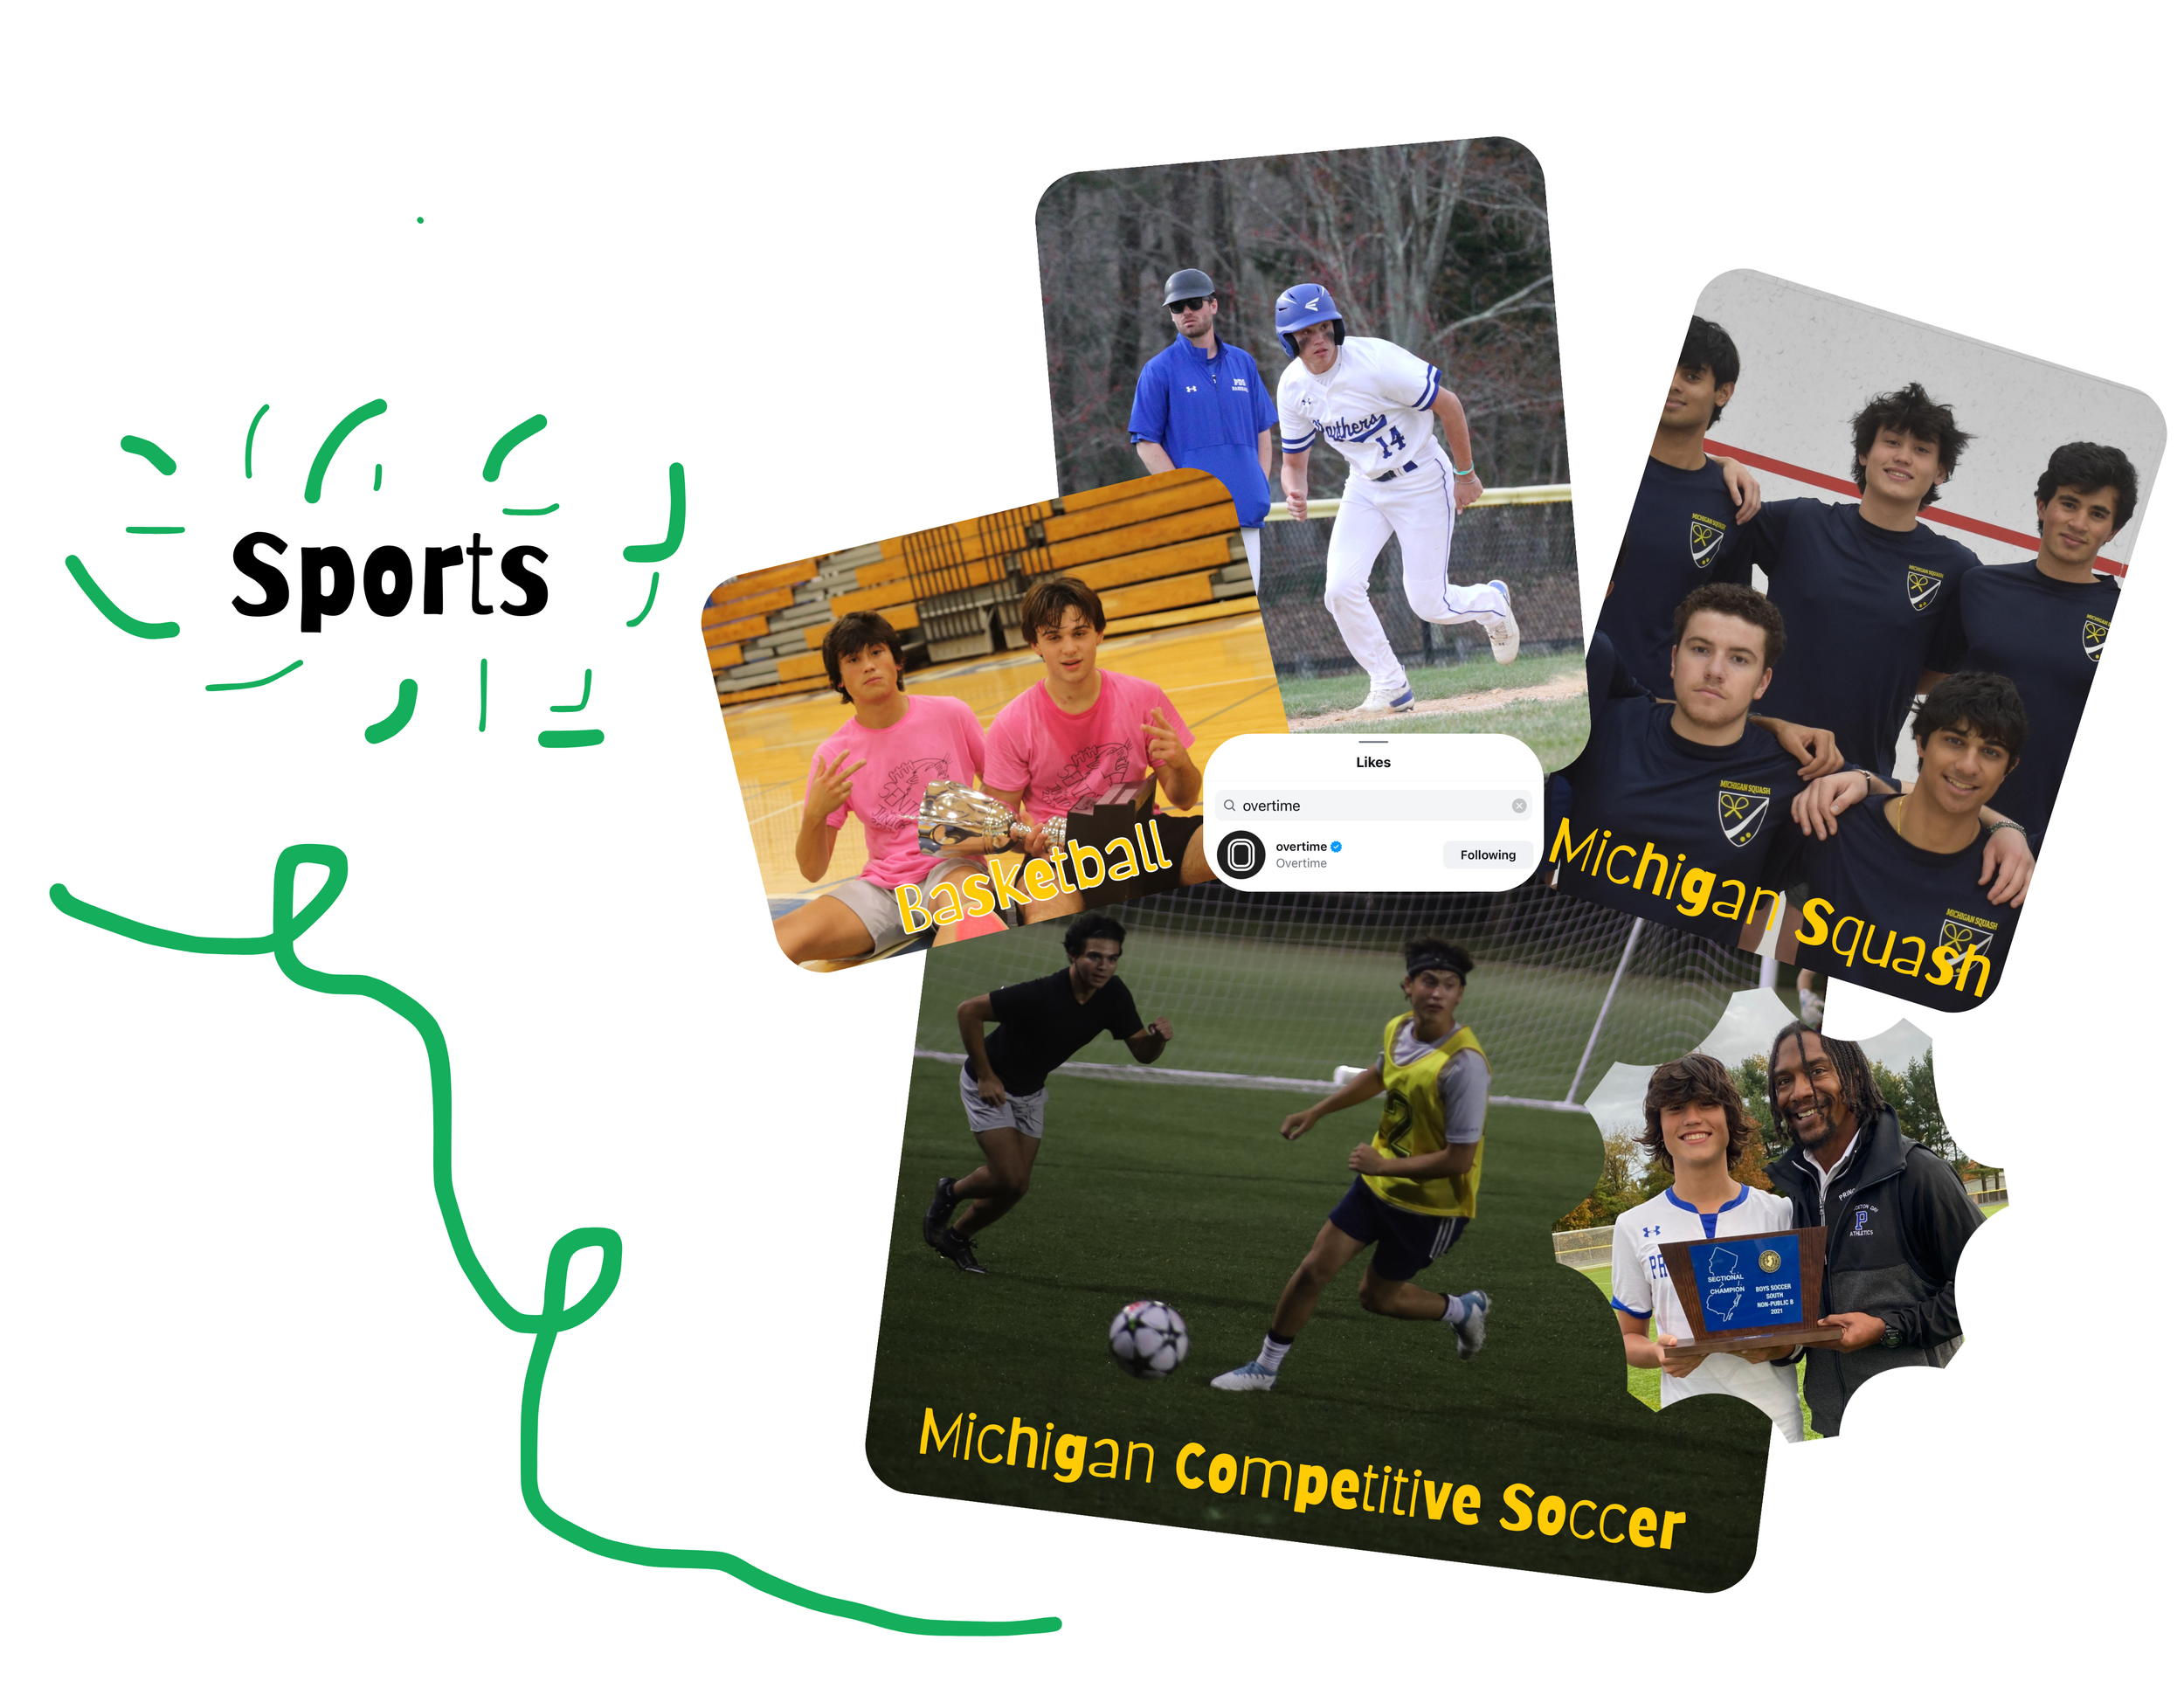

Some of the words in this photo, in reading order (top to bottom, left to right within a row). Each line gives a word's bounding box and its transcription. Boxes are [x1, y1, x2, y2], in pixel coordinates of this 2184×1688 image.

[1233, 377, 1247, 386] PDS
[1375, 425, 1406, 460] 14
[1908, 564, 1929, 574] MICHIGAN
[2086, 613, 2109, 626] MICHIGAN
[1357, 756, 1392, 769] Likes
[1719, 779, 1748, 792] MICHIGAN
[1747, 784, 1771, 795] SQUASH
[1242, 799, 1301, 812] overtime
[1275, 841, 1328, 853] overtime
[1461, 849, 1517, 862] Following
[1275, 857, 1328, 868] Overtime
[1946, 908, 1975, 924] MICHIGAN
[1974, 917, 1999, 930] SQUASH
[1855, 1210, 1868, 1231] P
[1707, 1274, 1745, 1283] SECTIONAL
[1710, 1285, 1745, 1295] CHAMPION
[1770, 1283, 1792, 1291] SOCCER
[1766, 1291, 1784, 1300] SOUTH
[1757, 1300, 1789, 1309] NON-PUBLIC
